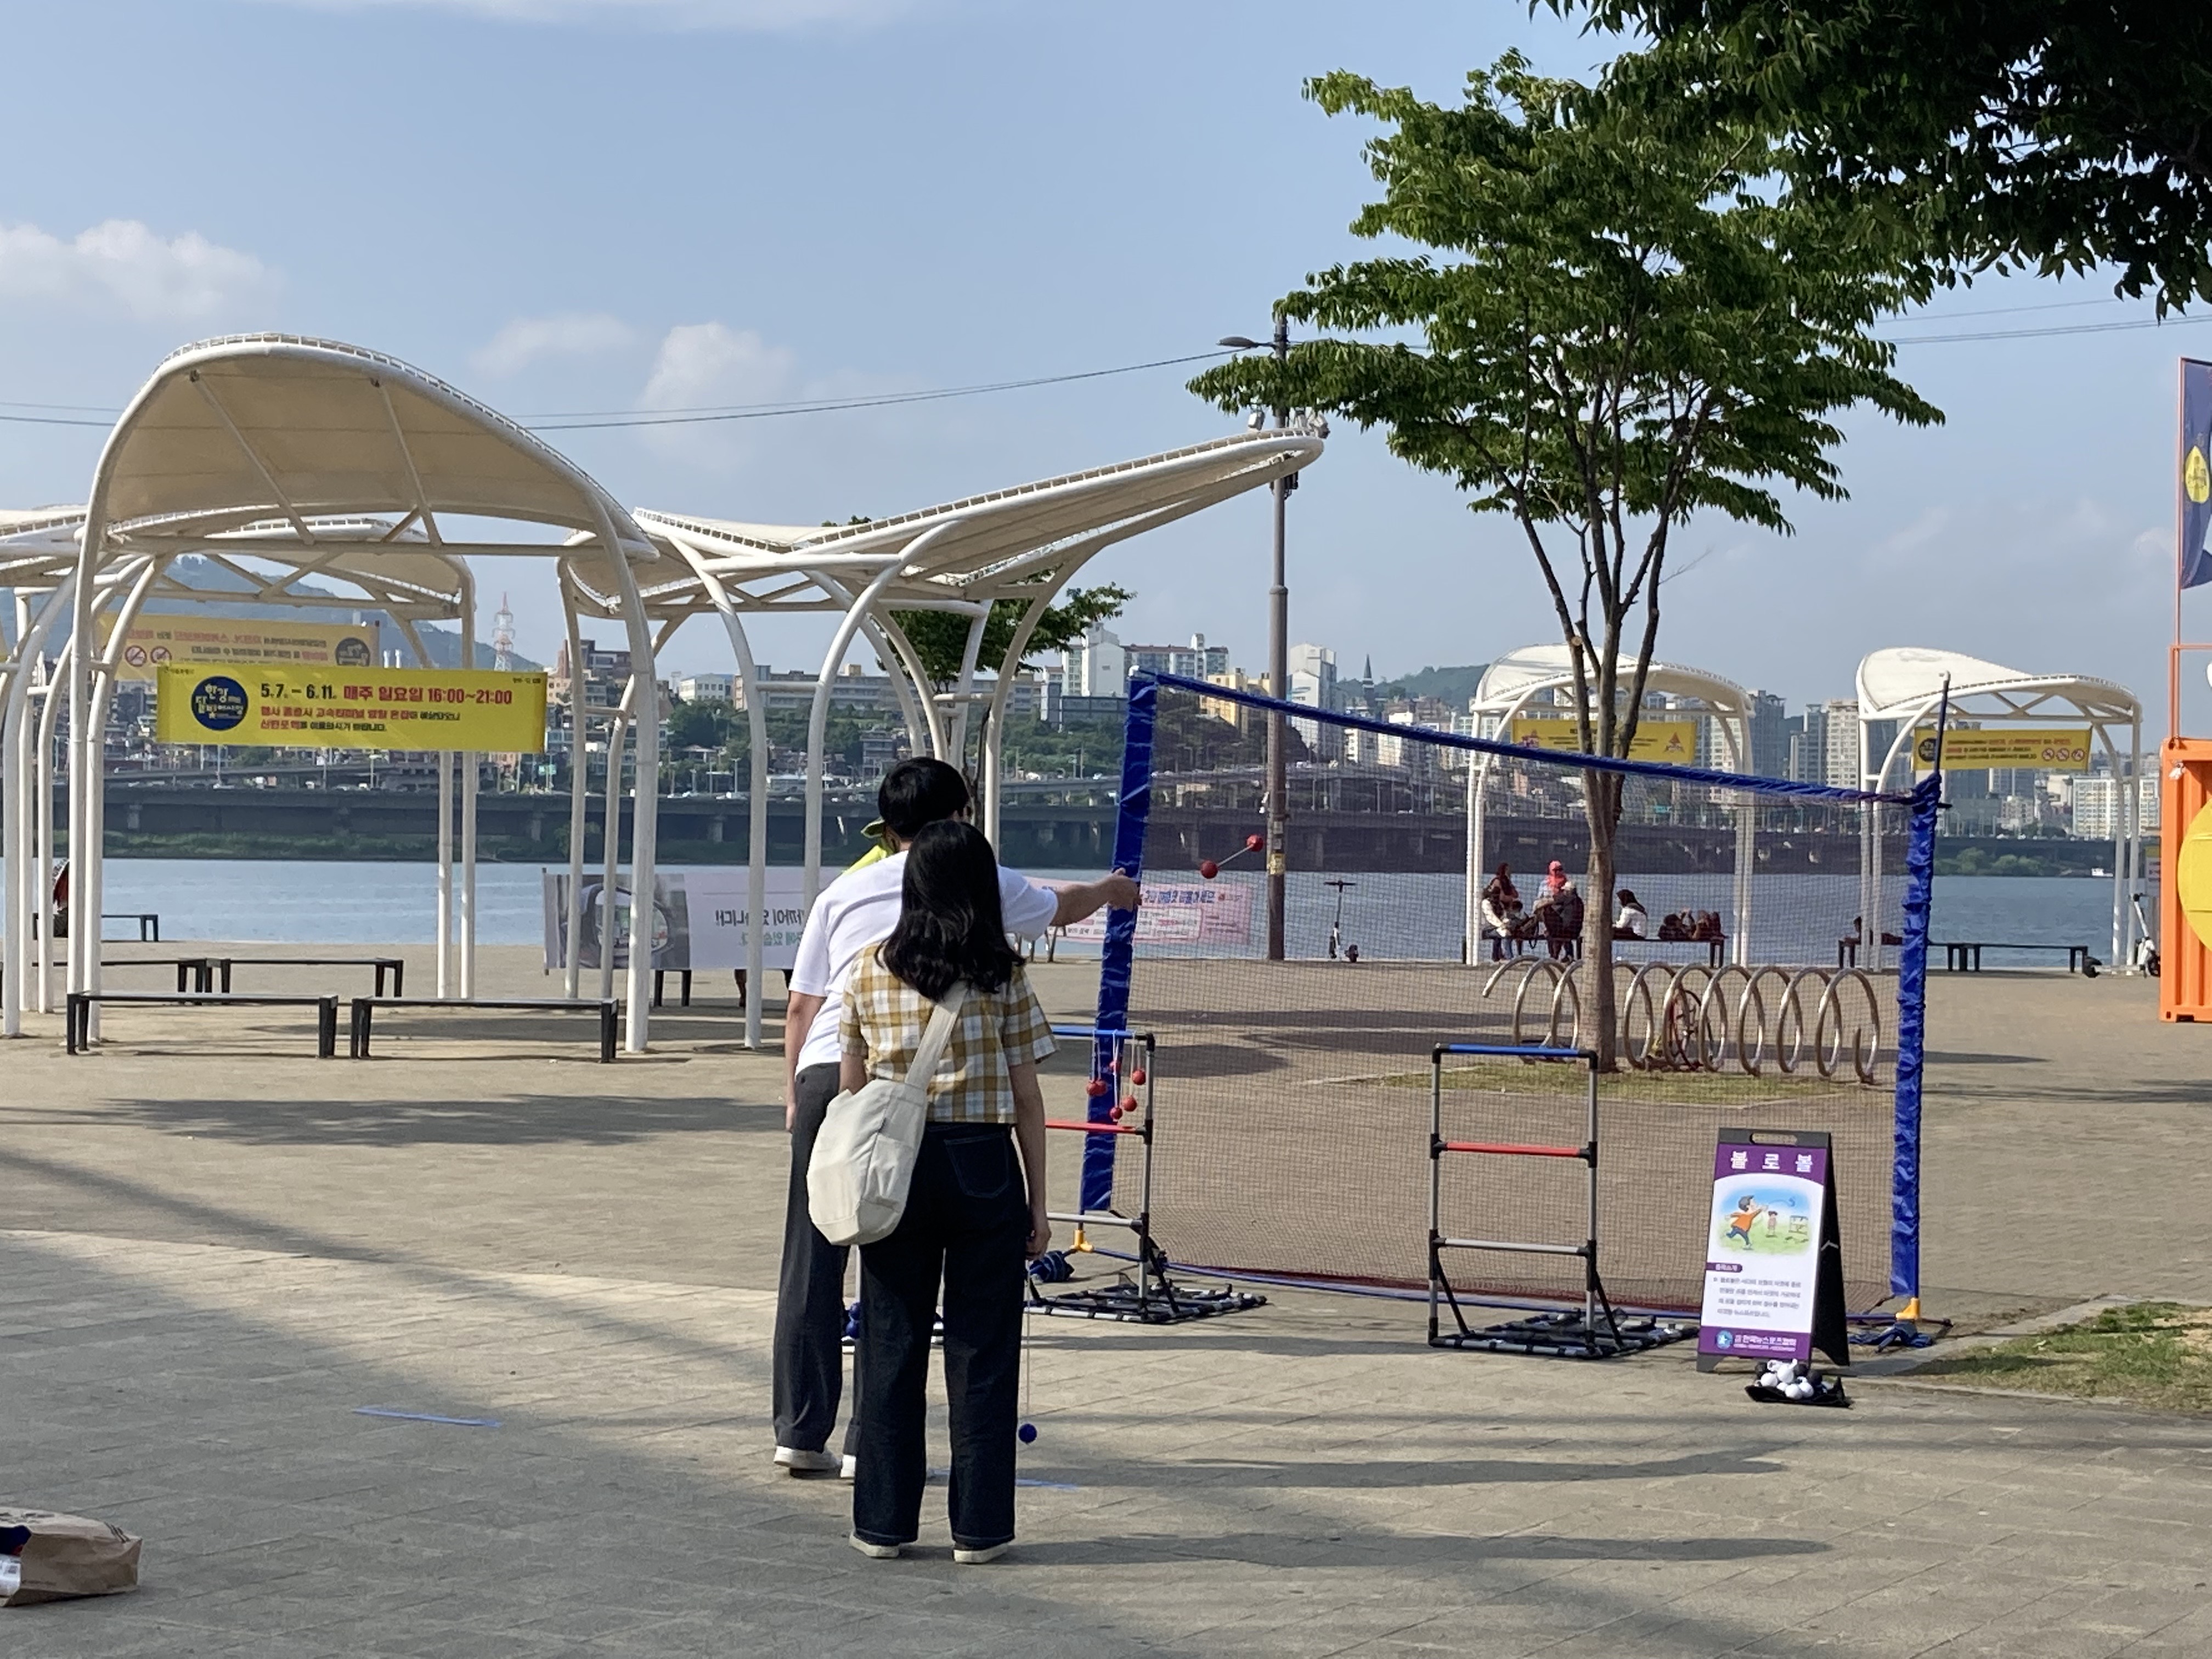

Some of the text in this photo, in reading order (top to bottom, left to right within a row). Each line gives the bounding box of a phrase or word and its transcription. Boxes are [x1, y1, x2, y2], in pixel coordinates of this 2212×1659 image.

[343, 685, 373, 701] 매주
[379, 686, 423, 701] 일요일
[427, 687, 512, 704] 16:00~21:00
